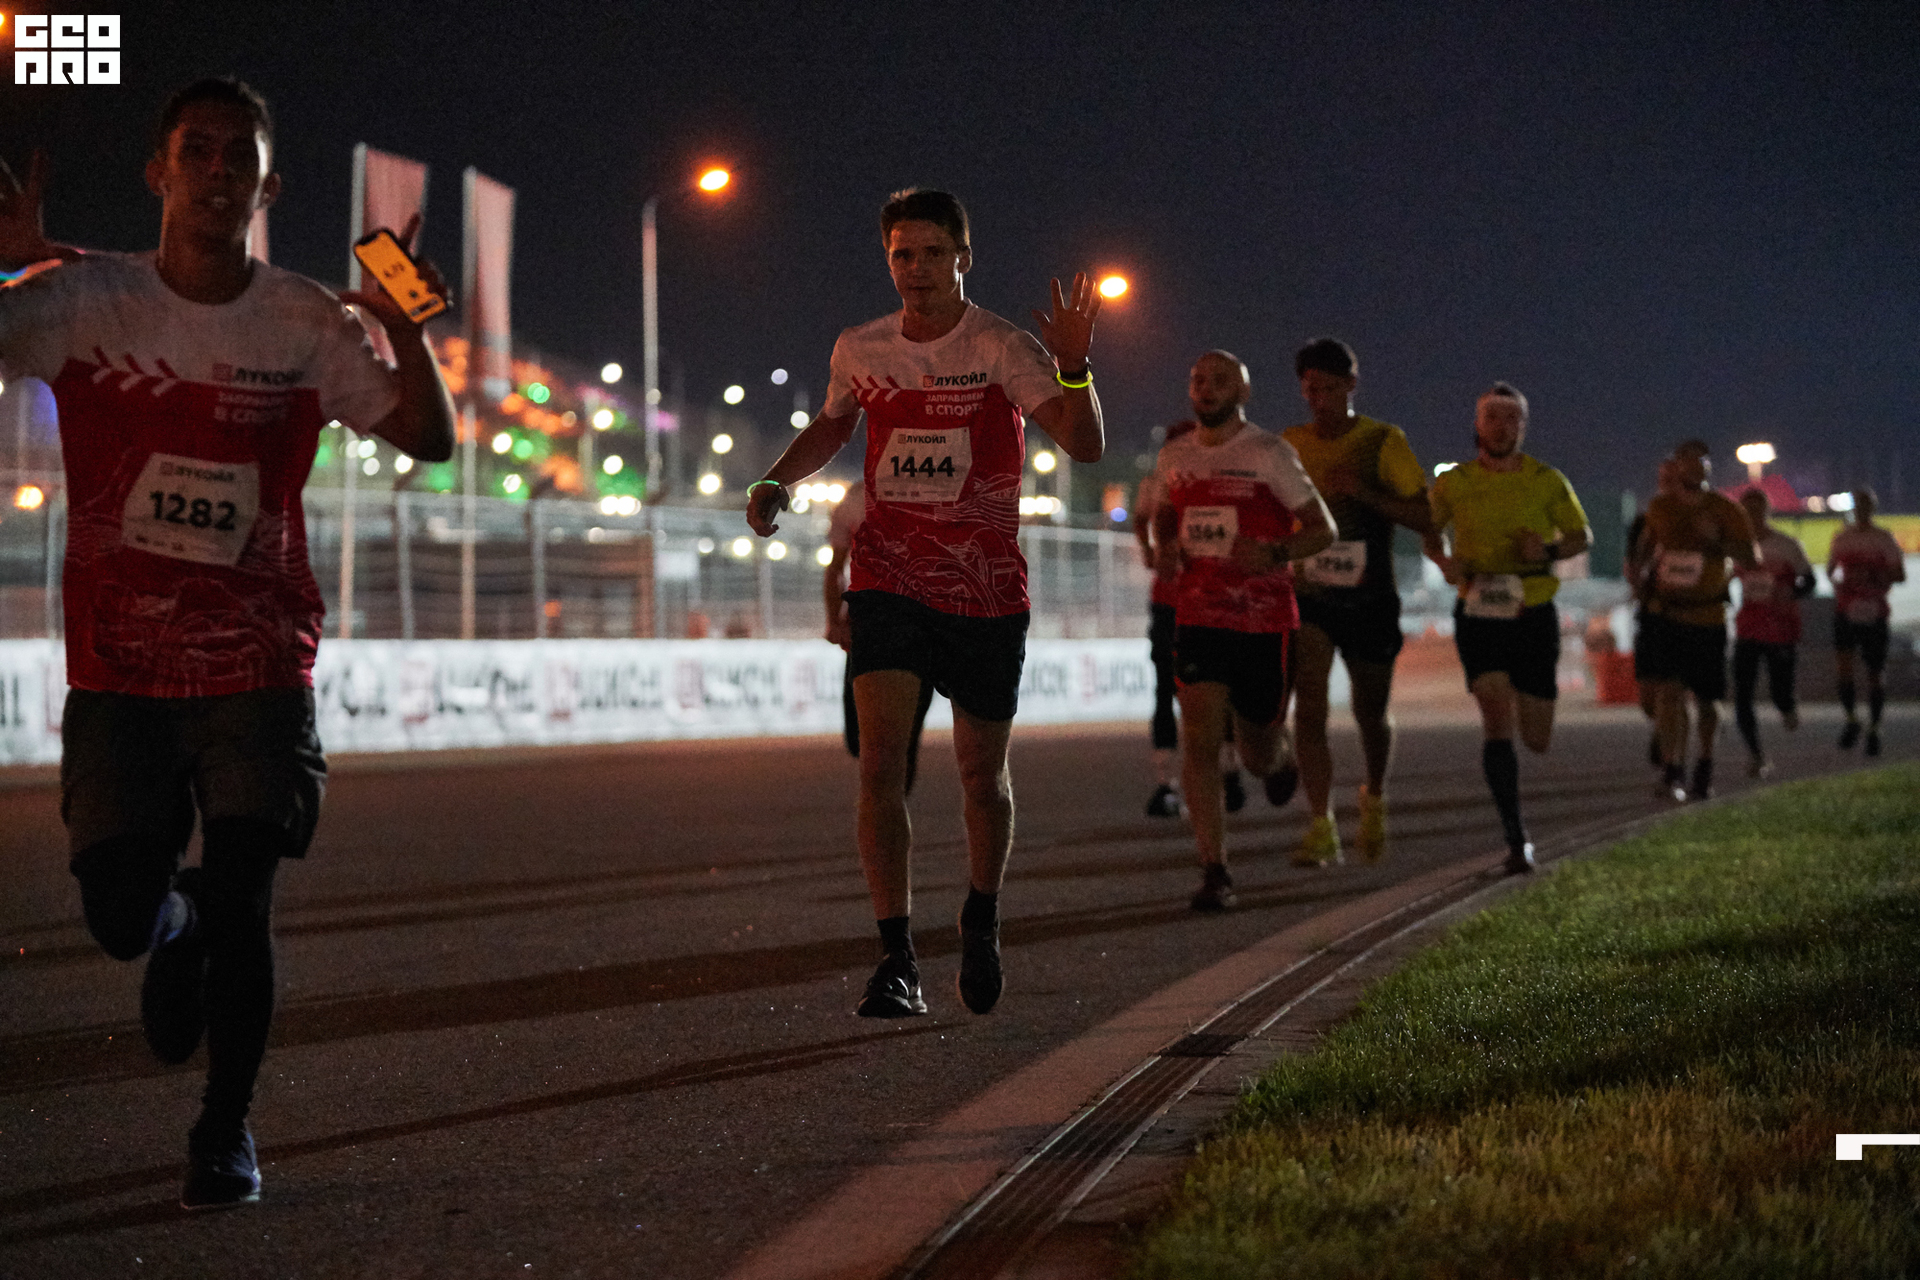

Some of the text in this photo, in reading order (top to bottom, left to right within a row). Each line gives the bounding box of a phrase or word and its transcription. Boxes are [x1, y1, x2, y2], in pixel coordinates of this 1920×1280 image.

[934, 372, 987, 386] ЛУКОЙЛ
[906, 434, 946, 444] ЛУКОЙЛ
[890, 456, 955, 477] 1444
[150, 490, 236, 531] 1282
